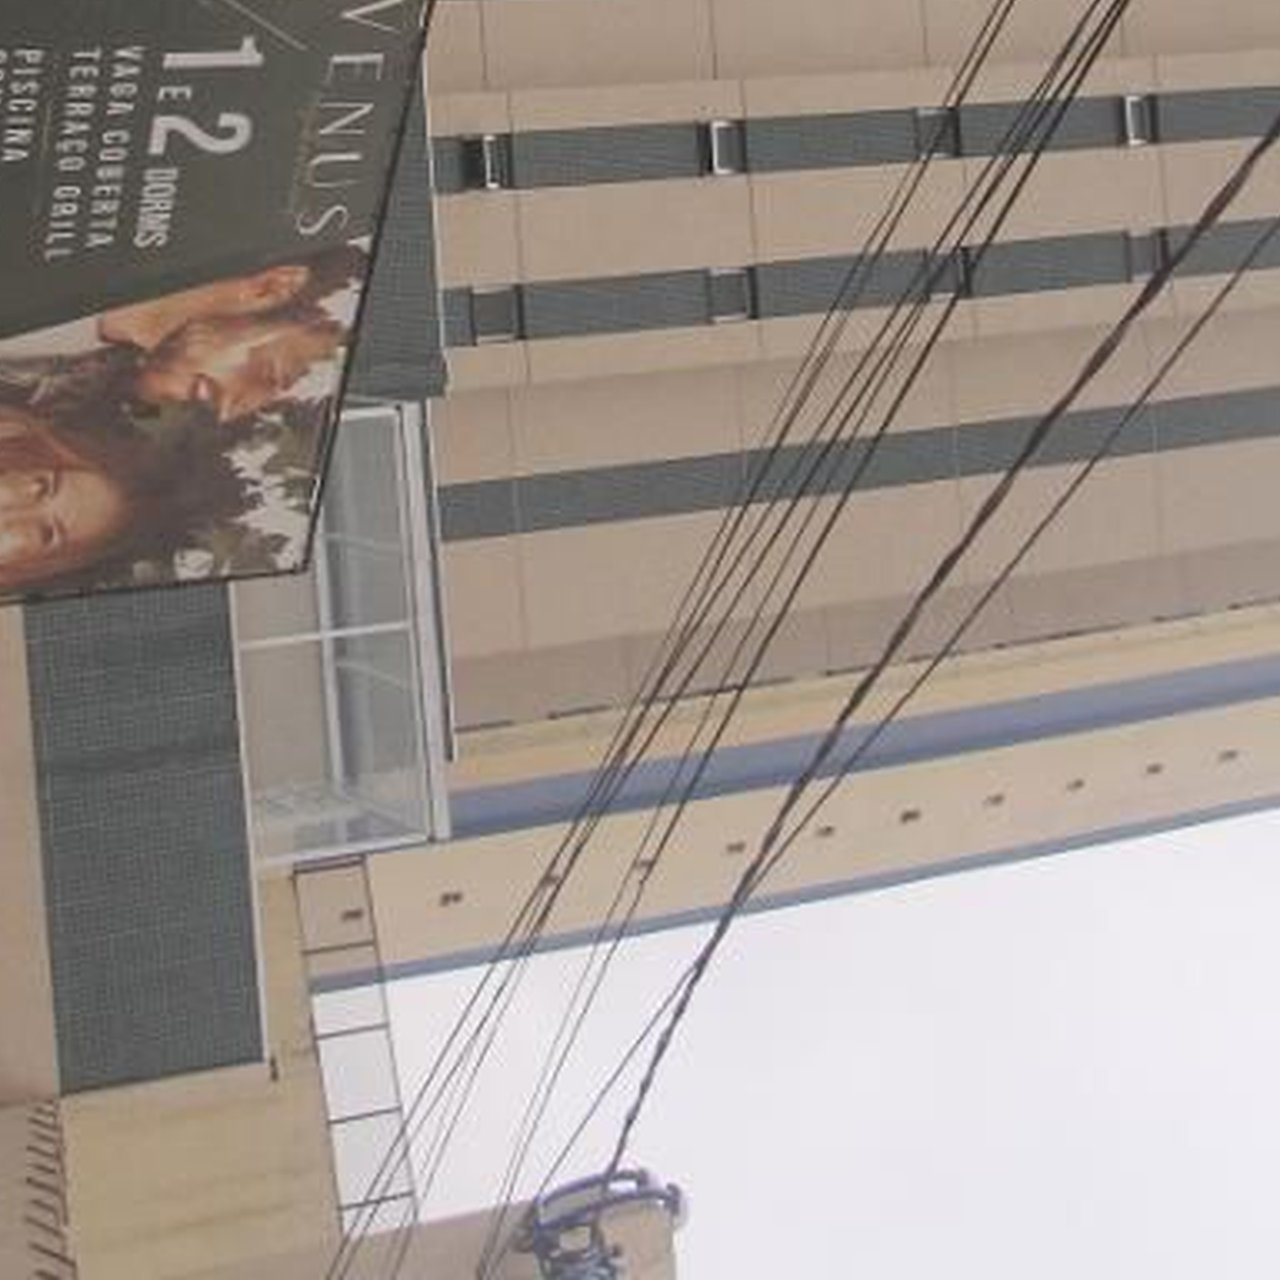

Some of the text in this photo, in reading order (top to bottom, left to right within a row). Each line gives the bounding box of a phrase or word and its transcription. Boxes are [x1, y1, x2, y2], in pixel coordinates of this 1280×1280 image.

[0, 48, 45, 162] PISCINA
[43, 47, 101, 262] TERRAÇO GRILL
[84, 46, 145, 248] VAGA COBERTA
[133, 35, 265, 248] 1 E 2 DORMS
